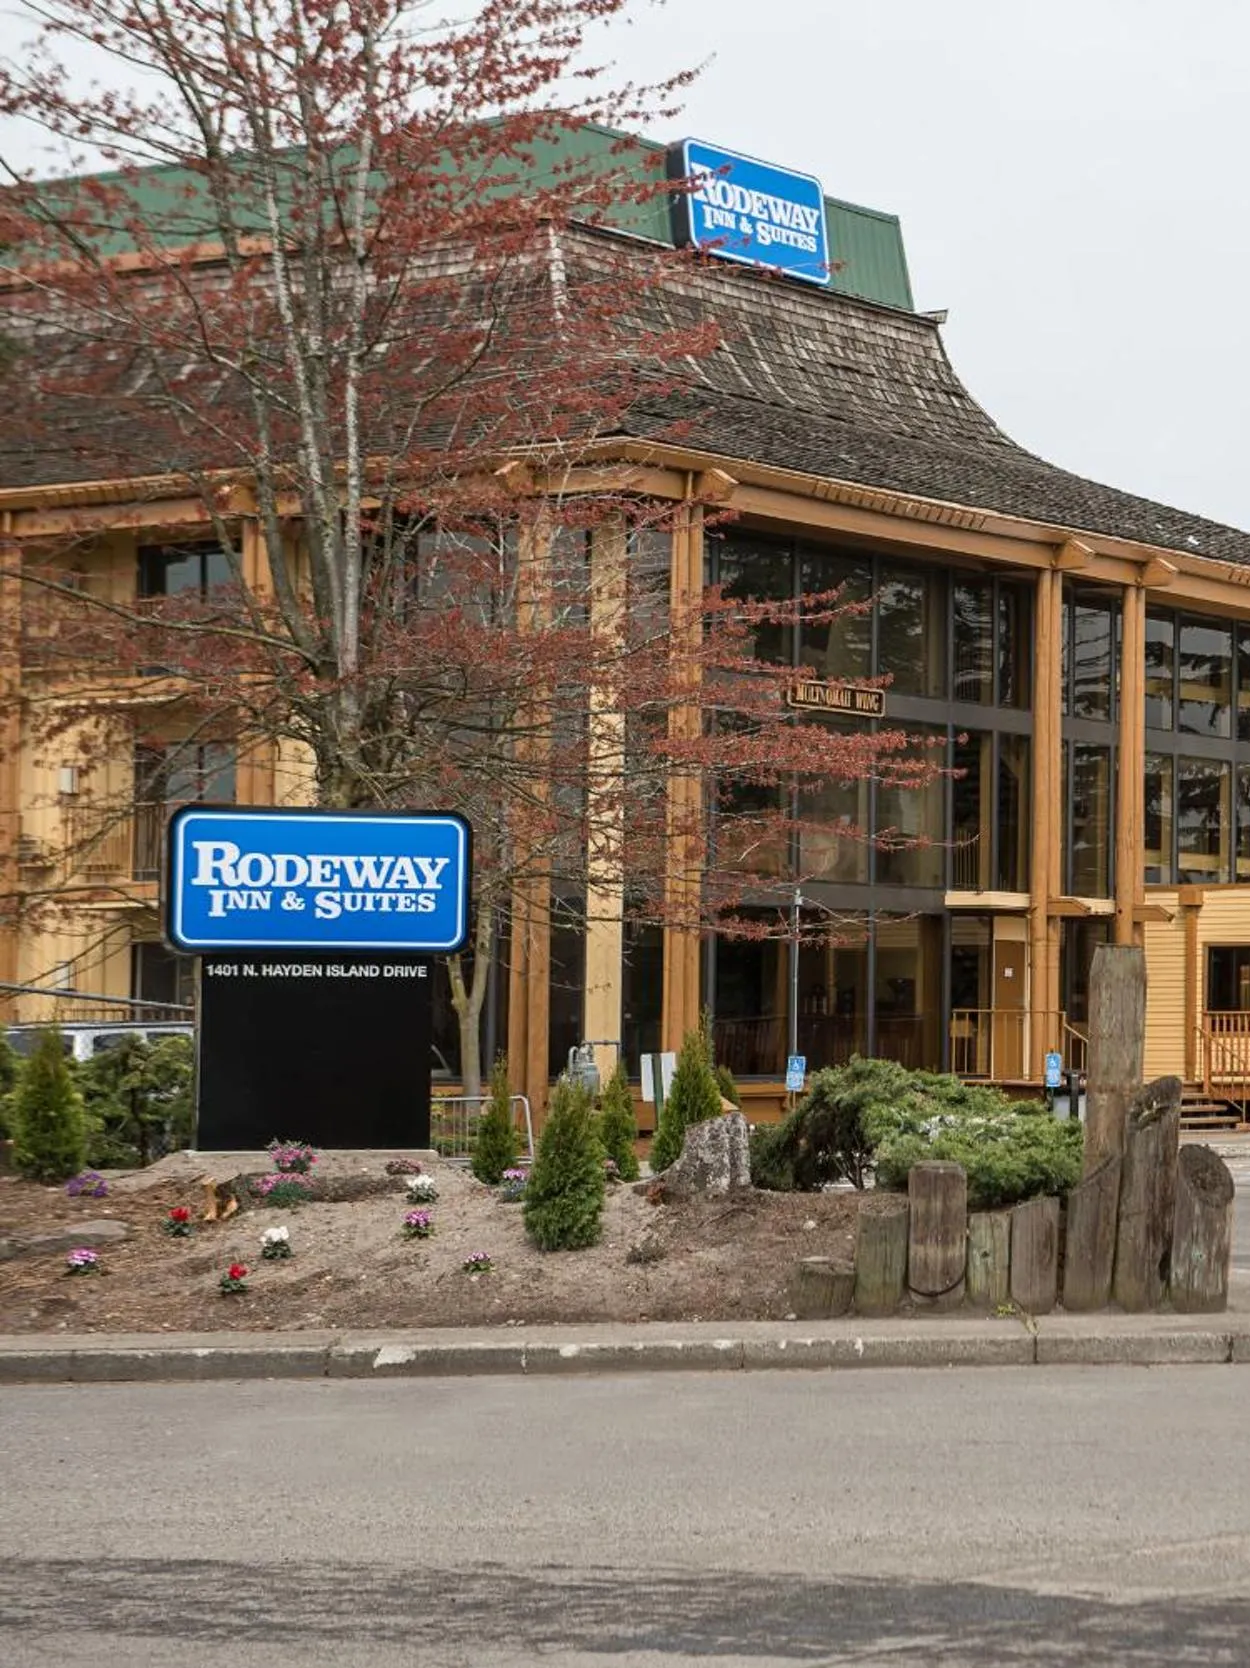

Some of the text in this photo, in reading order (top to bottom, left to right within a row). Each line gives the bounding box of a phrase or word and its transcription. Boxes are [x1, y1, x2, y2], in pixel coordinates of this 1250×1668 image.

[691, 162, 820, 236] RODEWAY
[702, 205, 817, 252] INN & SUITES
[191, 841, 450, 889] RODEWAY
[208, 890, 436, 919] INN & SUITES
[206, 964, 428, 979] 1401 N. HAYDEN ISLAND DRIVE
